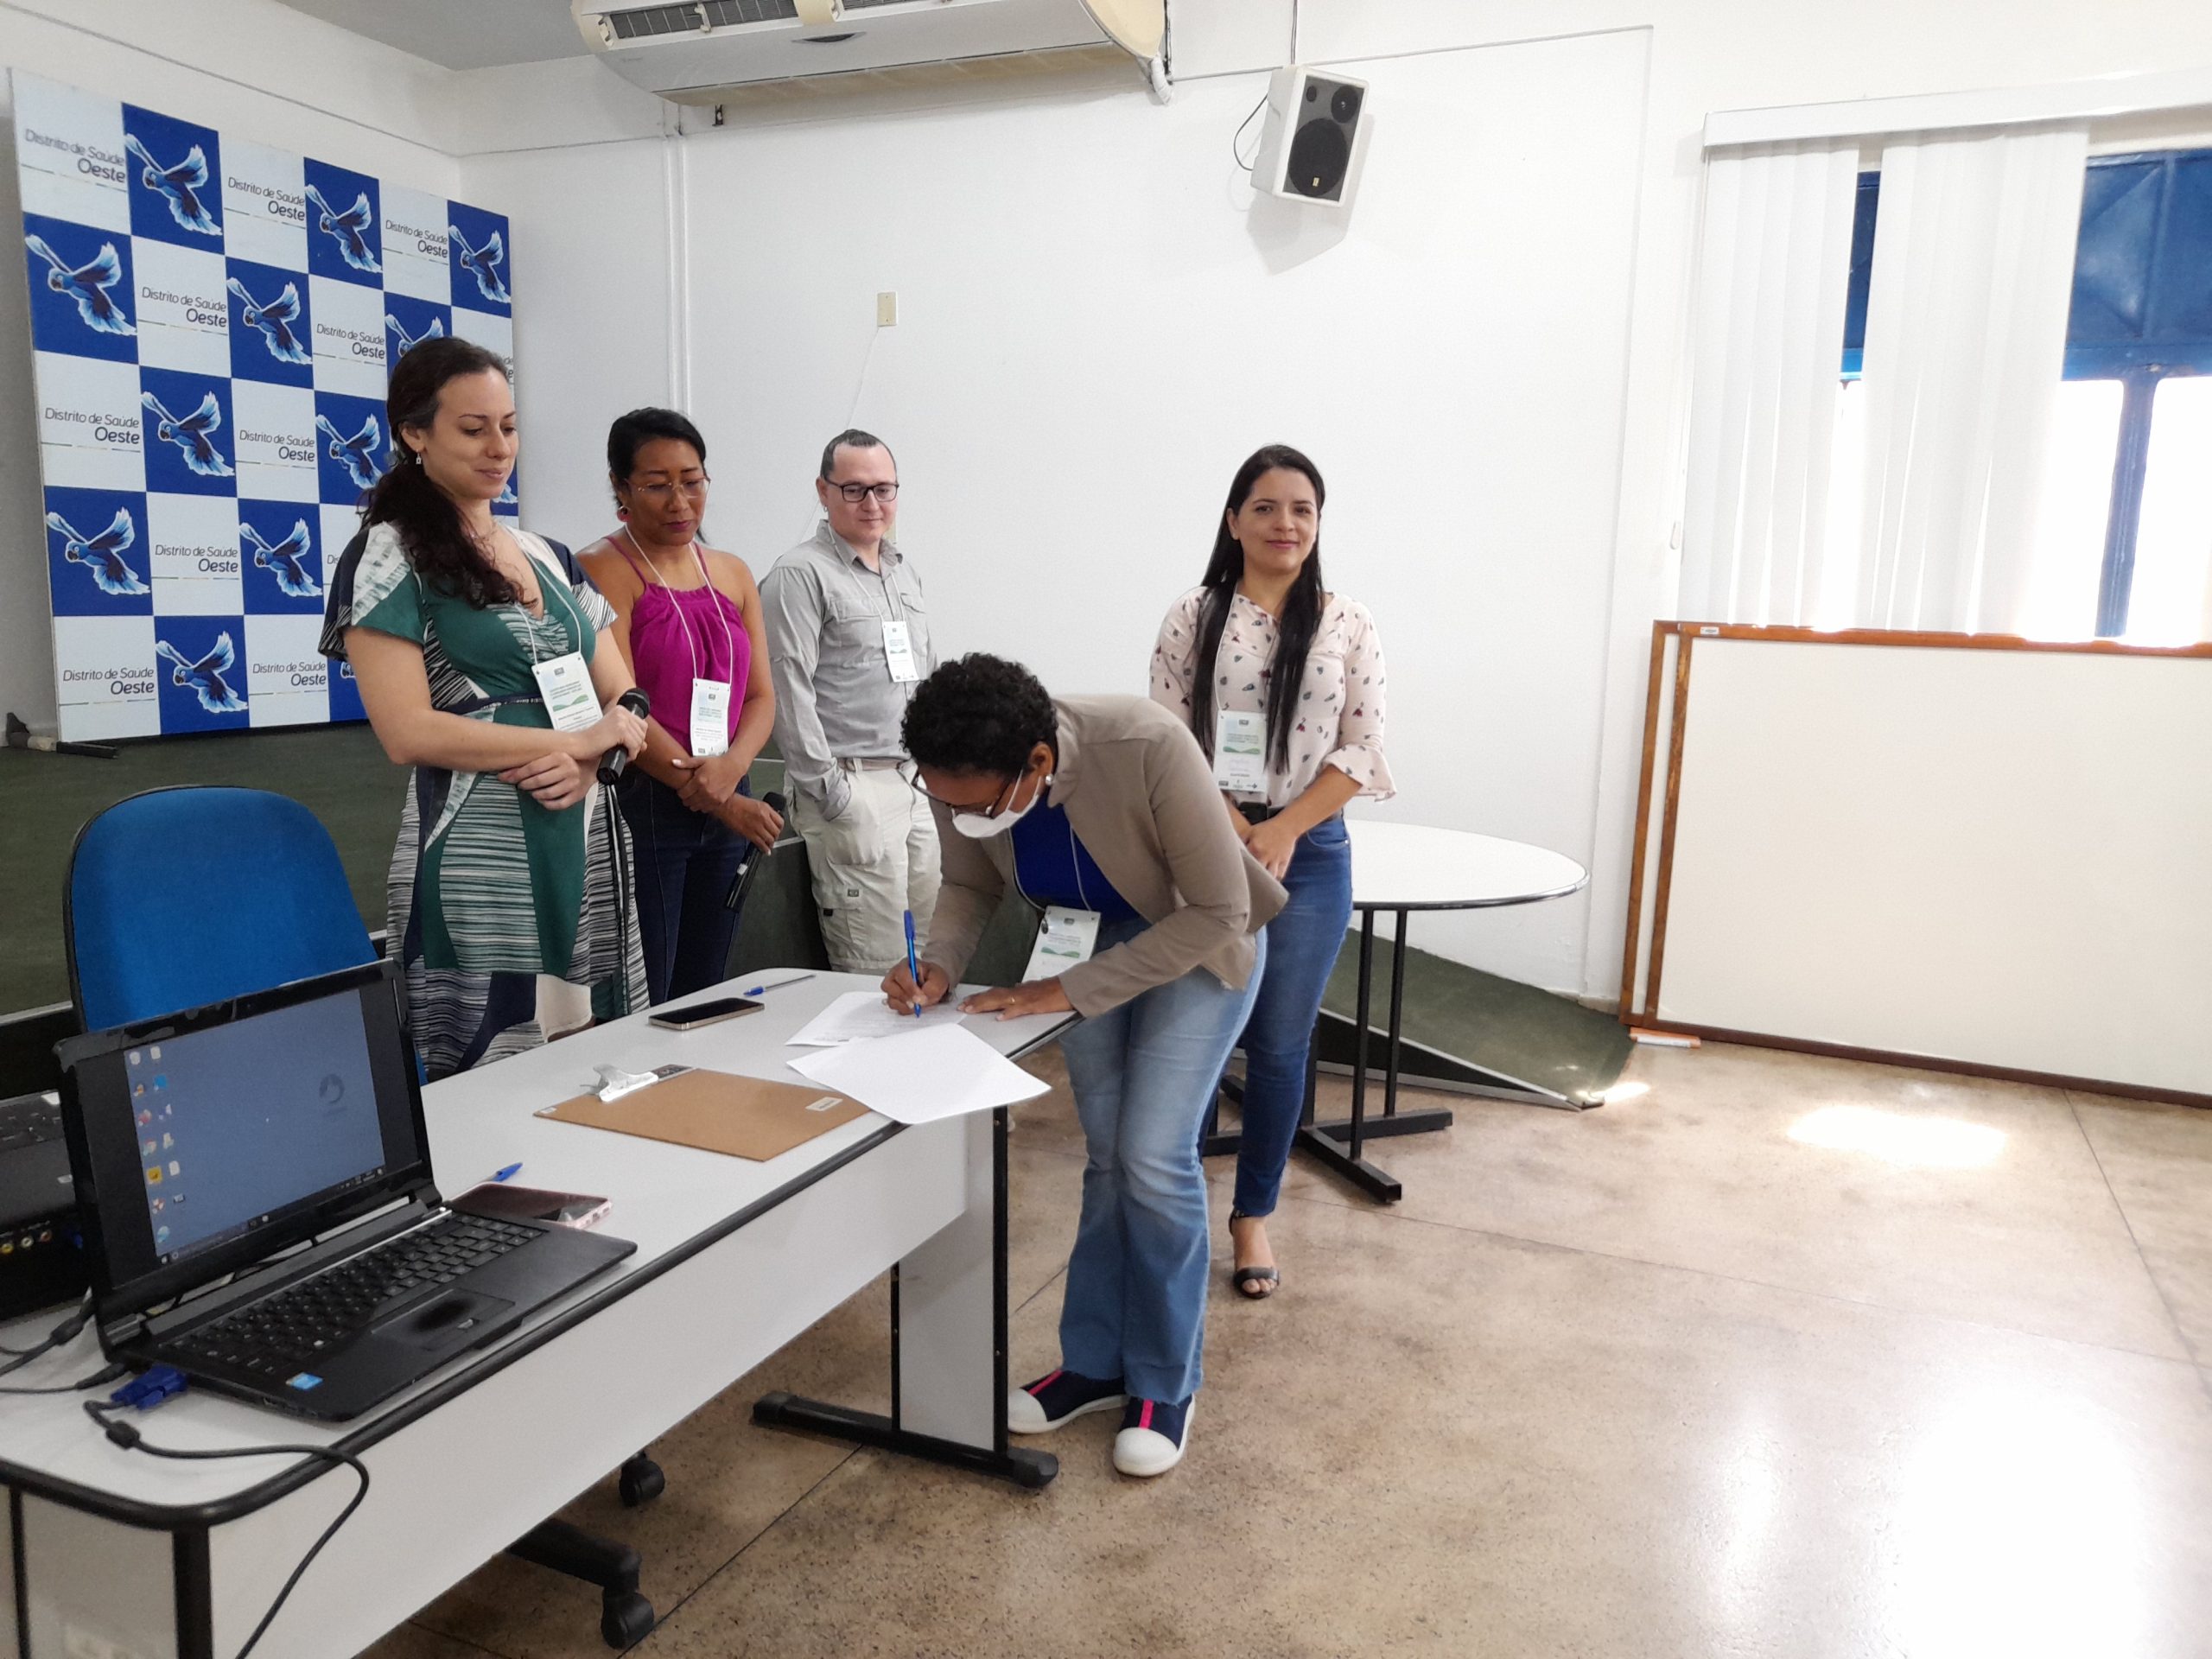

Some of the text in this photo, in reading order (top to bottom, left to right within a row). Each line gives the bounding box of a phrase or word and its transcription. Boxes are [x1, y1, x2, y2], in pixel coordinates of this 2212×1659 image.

[78, 157, 125, 182] Oeste
[228, 176, 262, 195] Distrito
[263, 188, 275, 198] de
[268, 200, 305, 221] Oeste
[413, 228, 423, 238] de
[417, 239, 448, 258] Oeste
[142, 286, 179, 303] Distrito
[181, 295, 194, 306] de
[186, 308, 226, 327] Oeste
[316, 323, 346, 339] Distrito
[347, 330, 359, 340] de
[352, 342, 385, 359] Oeste
[45, 407, 86, 423] Distrito
[88, 413, 103, 424] de
[94, 426, 140, 444] Oeste
[239, 429, 273, 443] Distrito
[273, 434, 285, 444] de
[278, 446, 315, 462] Oeste
[155, 544, 192, 556] Distrito
[193, 546, 206, 556] de
[198, 558, 238, 573] Oeste
[63, 669, 103, 682] Distrito
[104, 668, 118, 680] de
[252, 663, 285, 674] Distrito
[286, 662, 297, 672] de
[110, 680, 155, 695] Oeste
[290, 673, 327, 686] Oeste
